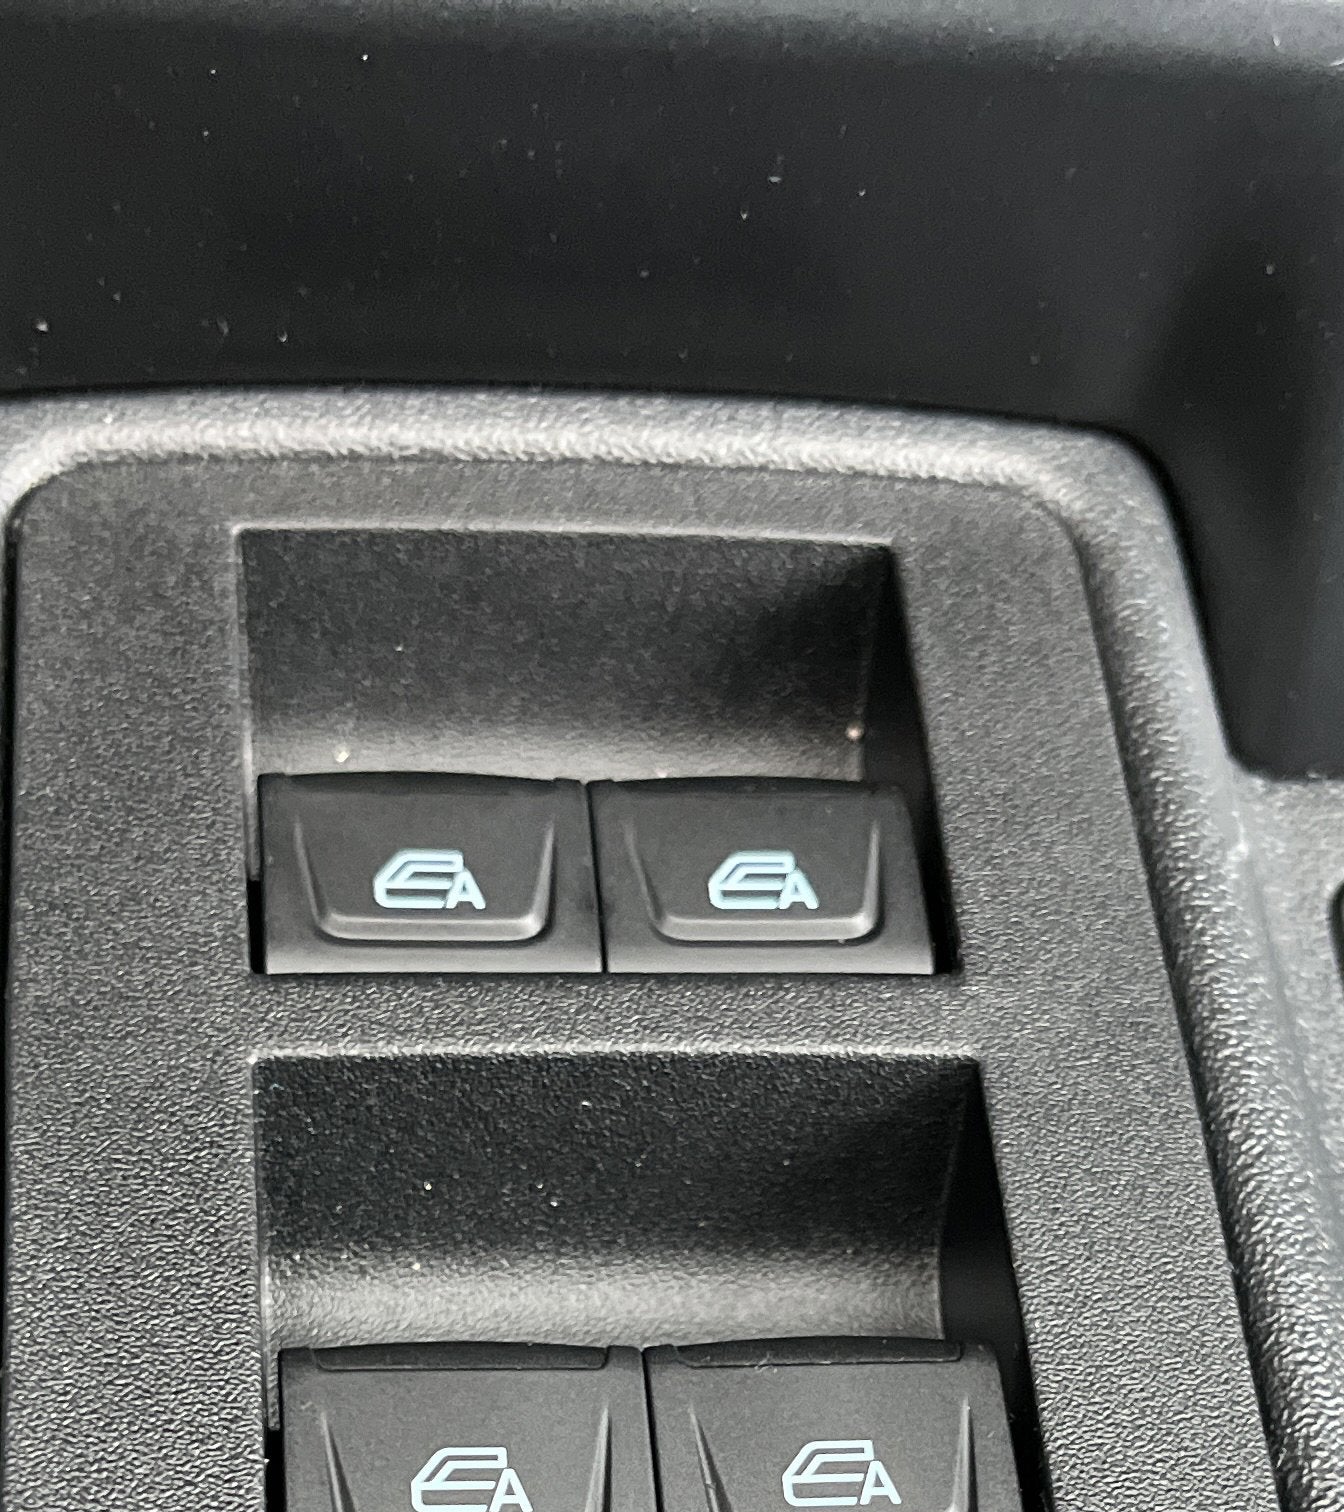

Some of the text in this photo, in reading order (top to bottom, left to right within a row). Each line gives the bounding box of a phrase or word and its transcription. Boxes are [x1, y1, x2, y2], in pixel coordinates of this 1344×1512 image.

[446, 868, 487, 910] A
[778, 868, 820, 910] A
[859, 1460, 902, 1507] A
